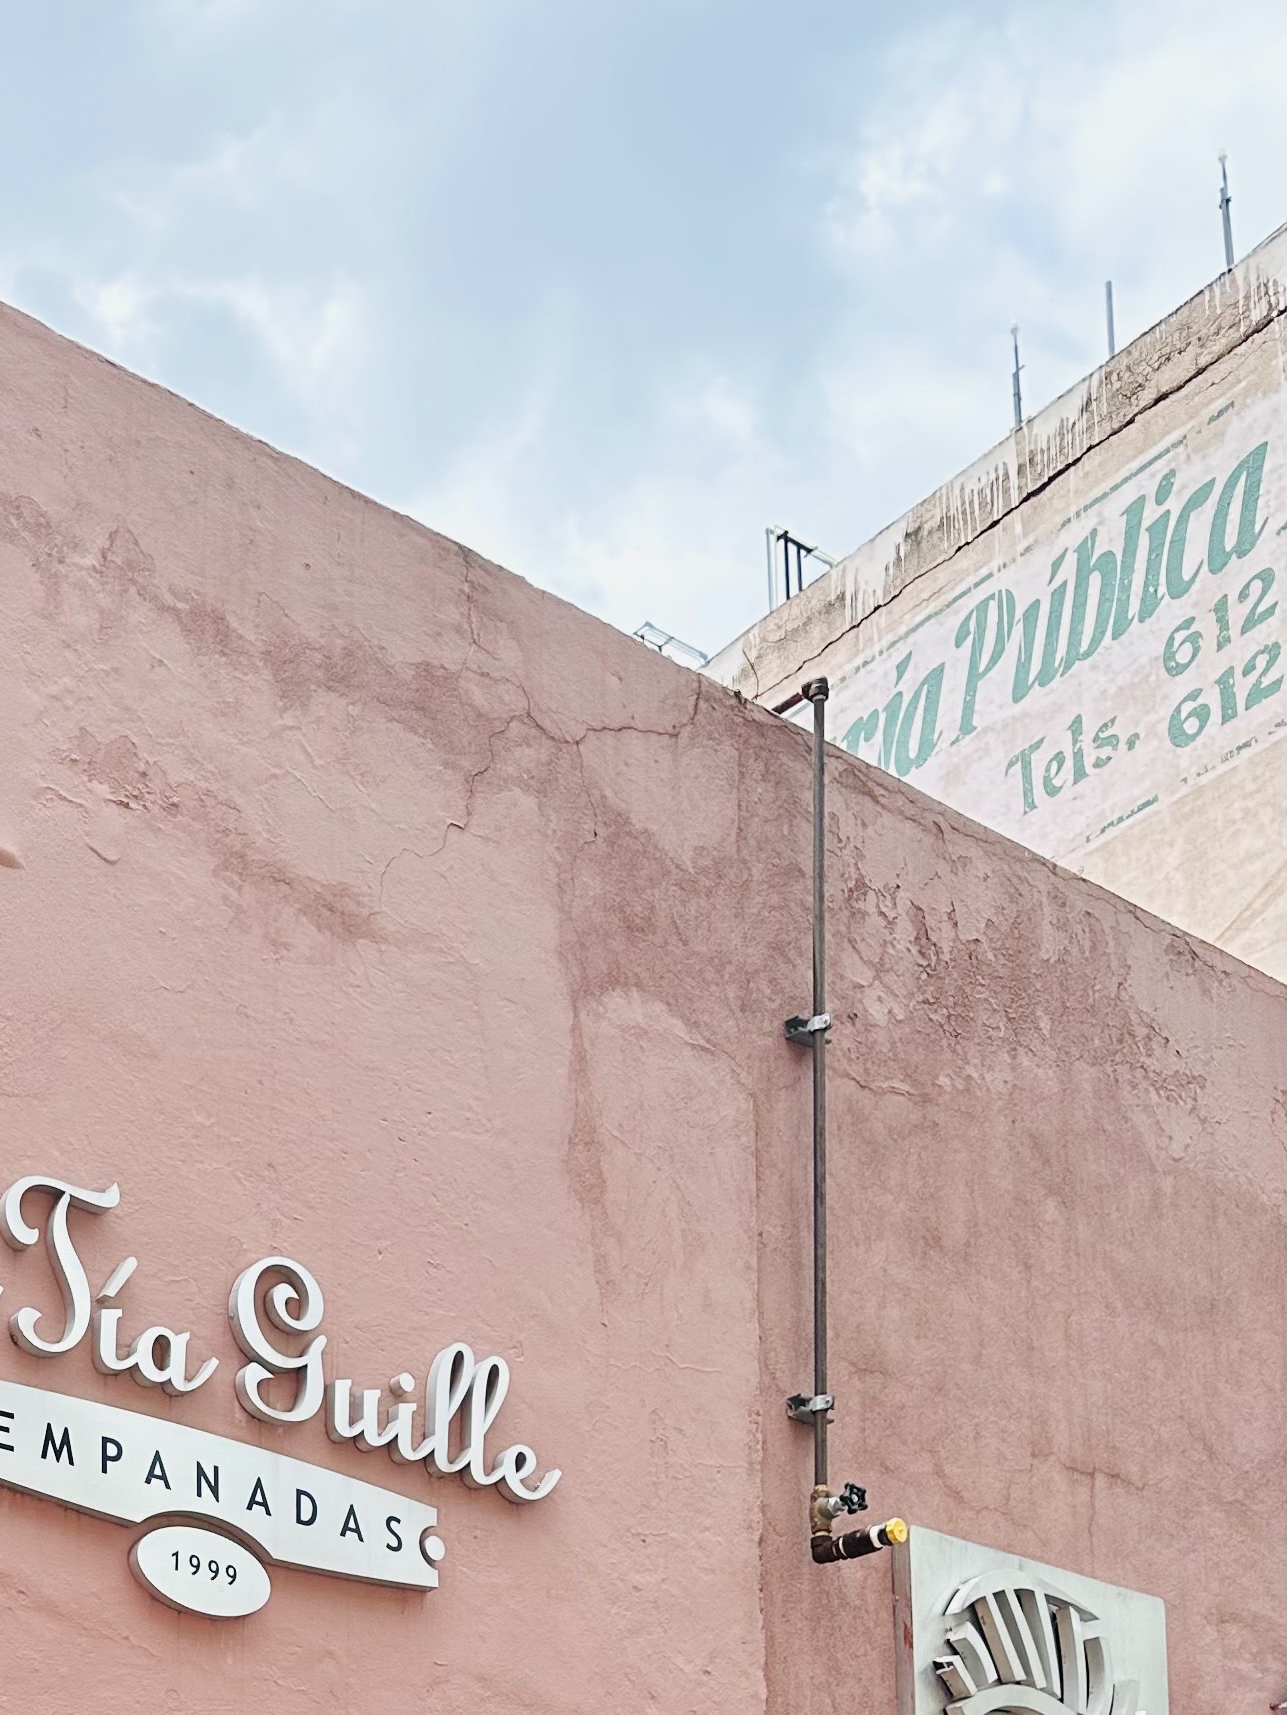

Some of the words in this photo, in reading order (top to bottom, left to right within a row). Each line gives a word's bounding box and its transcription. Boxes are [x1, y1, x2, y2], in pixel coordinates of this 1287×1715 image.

[829, 650, 944, 777] ría
[952, 440, 1268, 746] Pública
[1163, 567, 1278, 678] 612
[1003, 714, 1141, 815] Tels.
[1168, 641, 1284, 749] 612
[228, 1255, 562, 1503] Guille
[170, 1549, 240, 1589] 1999
